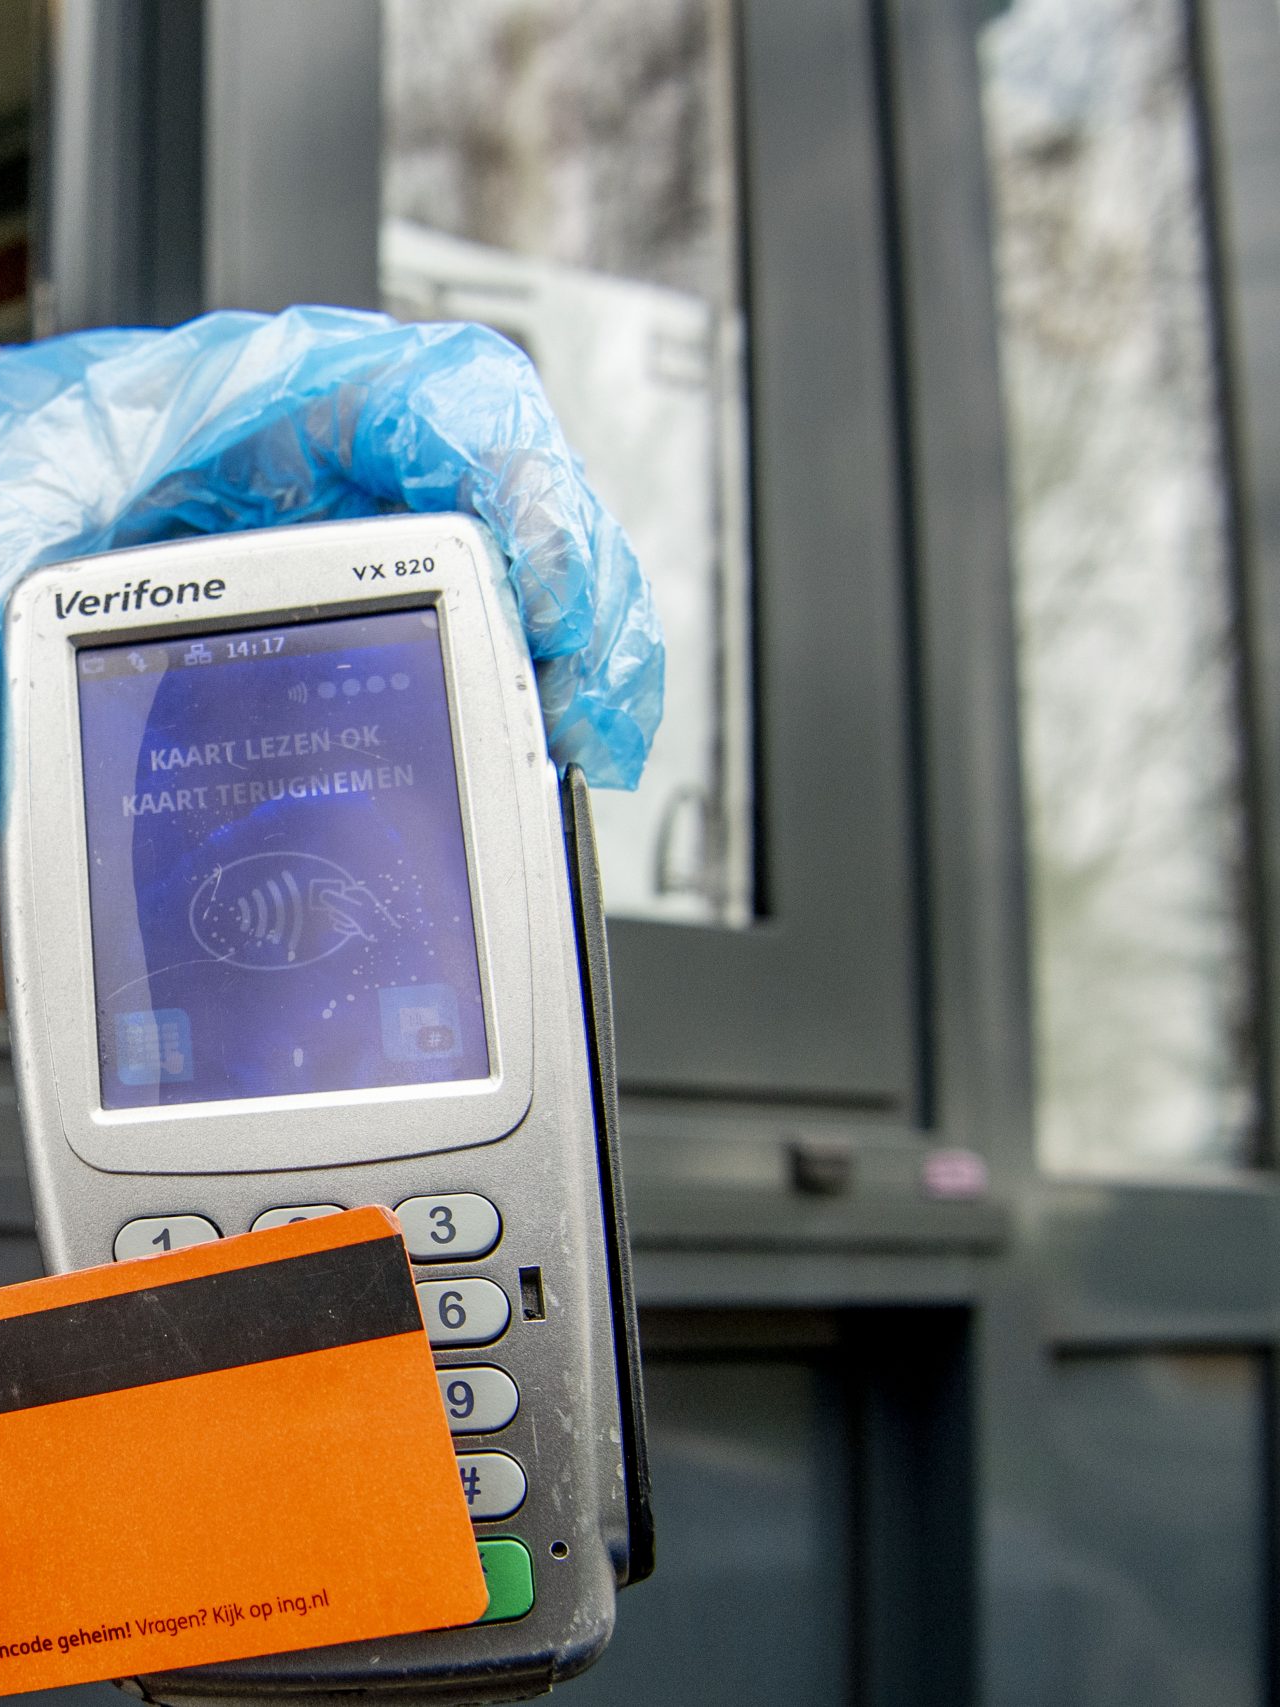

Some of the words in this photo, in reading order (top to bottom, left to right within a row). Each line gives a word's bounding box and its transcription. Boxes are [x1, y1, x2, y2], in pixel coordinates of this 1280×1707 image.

[352, 564, 386, 582] VX
[395, 557, 435, 575] 820
[54, 578, 226, 619] Verifone
[226, 637, 285, 659] 14:17
[150, 741, 236, 771] KAART
[244, 727, 331, 761] LEZEN
[340, 724, 381, 750] OK
[122, 786, 208, 818] KAART
[216, 763, 414, 806] TERUGNEMEN
[152, 1228, 171, 1251] 1
[429, 1206, 458, 1245] 3
[438, 1291, 466, 1329] 6
[447, 1381, 475, 1419] 9
[460, 1466, 482, 1505] #
[58, 1622, 132, 1654] geheim!
[135, 1609, 208, 1638] Vragen?
[212, 1603, 245, 1628] Kijk
[249, 1601, 274, 1621] op
[277, 1588, 331, 1618] ing.nl
